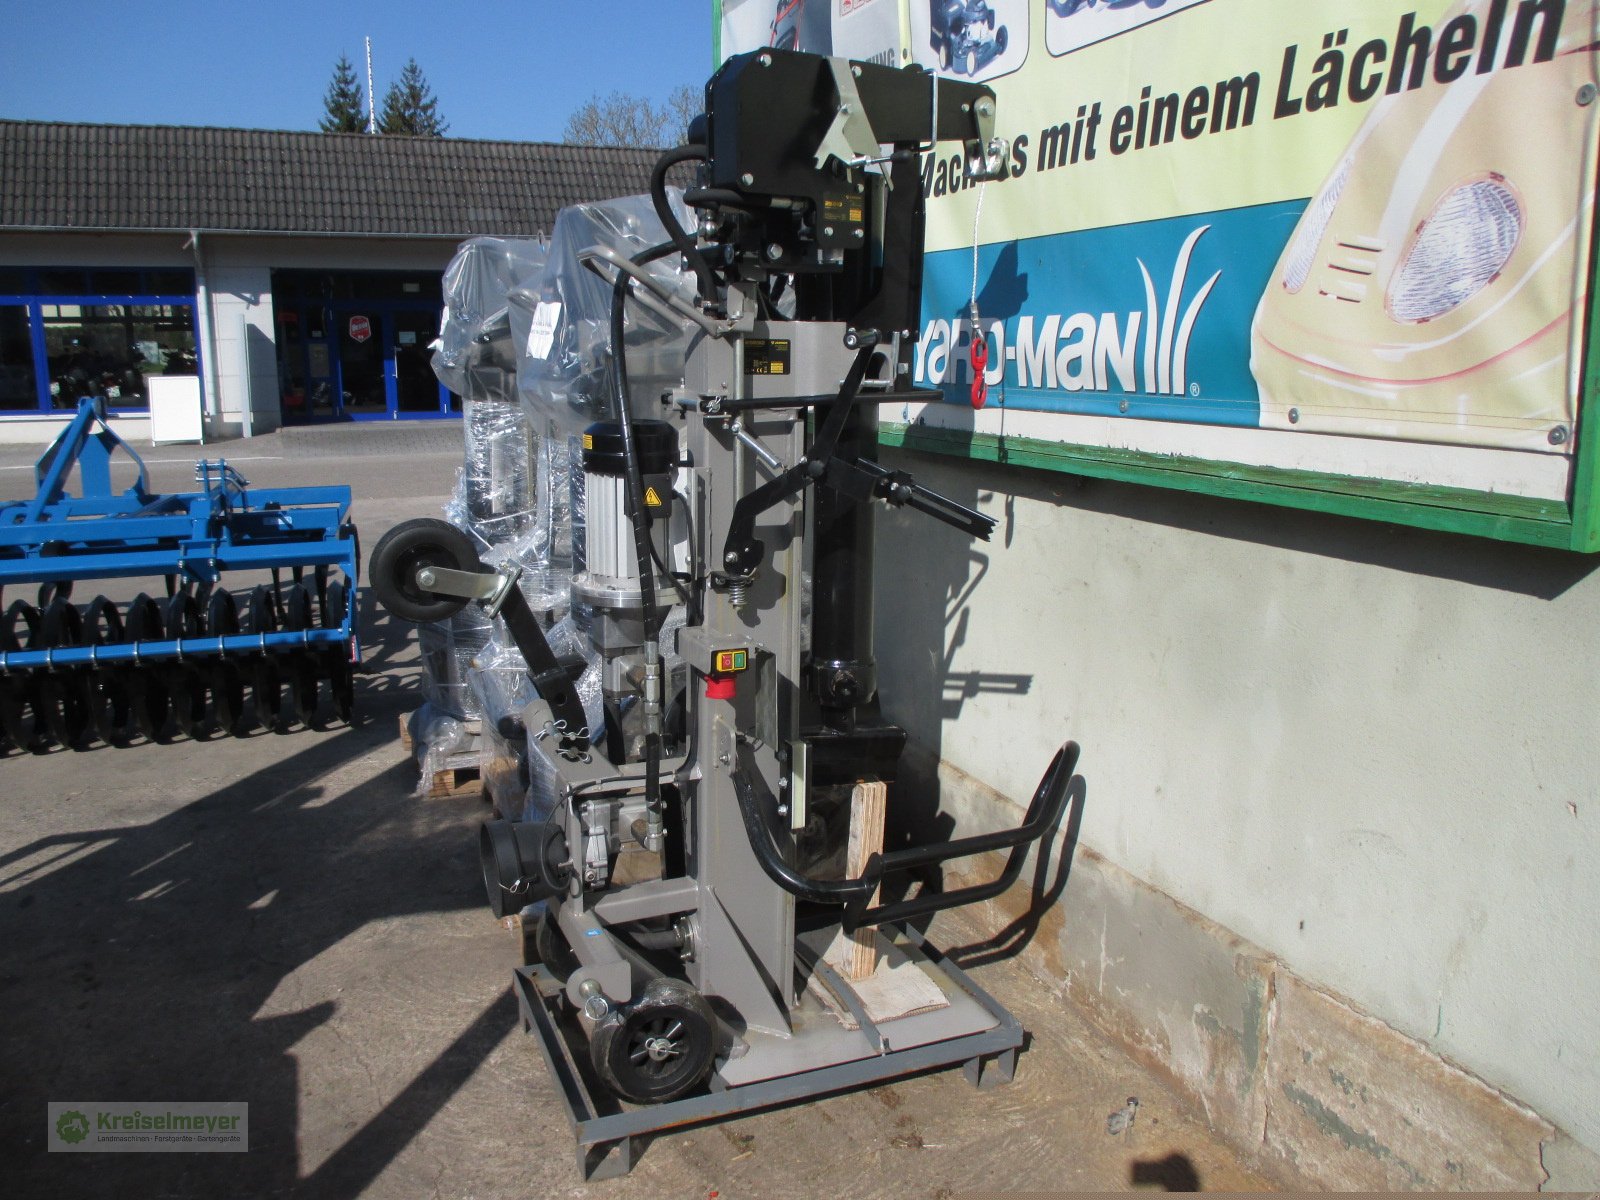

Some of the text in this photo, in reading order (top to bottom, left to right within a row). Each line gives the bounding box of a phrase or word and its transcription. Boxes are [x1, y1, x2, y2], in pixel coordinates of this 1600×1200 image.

[1037, 102, 1101, 172] mit
[1110, 71, 1260, 156] einem
[1273, 0, 1565, 120] Lächeln
